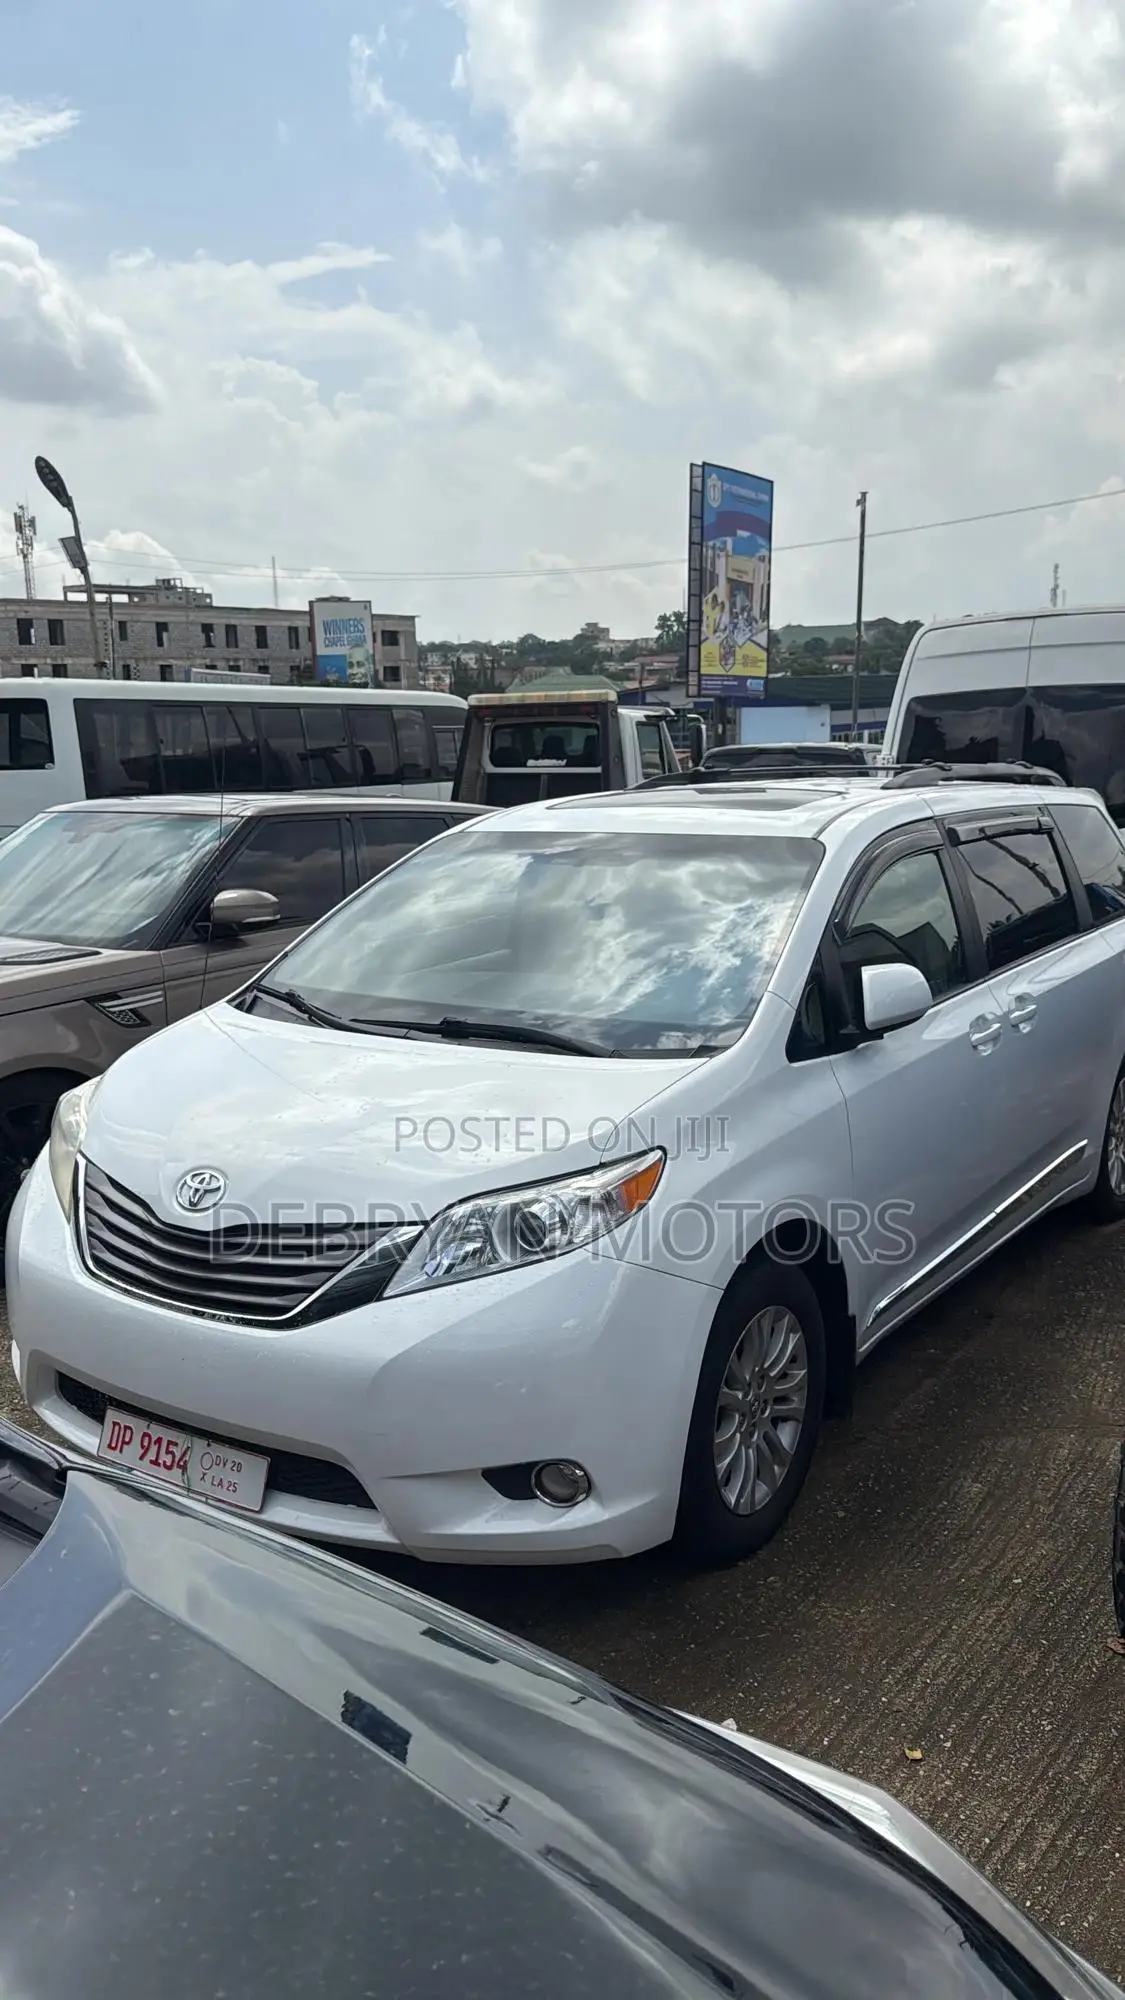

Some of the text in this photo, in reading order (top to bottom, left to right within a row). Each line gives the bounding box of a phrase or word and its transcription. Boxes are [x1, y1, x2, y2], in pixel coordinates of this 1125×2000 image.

[323, 618, 365, 636] WINNERS
[107, 1420, 191, 1473] DP 9154
[214, 1455, 243, 1473] DV 20
[200, 1472, 239, 1494] X LA 25
